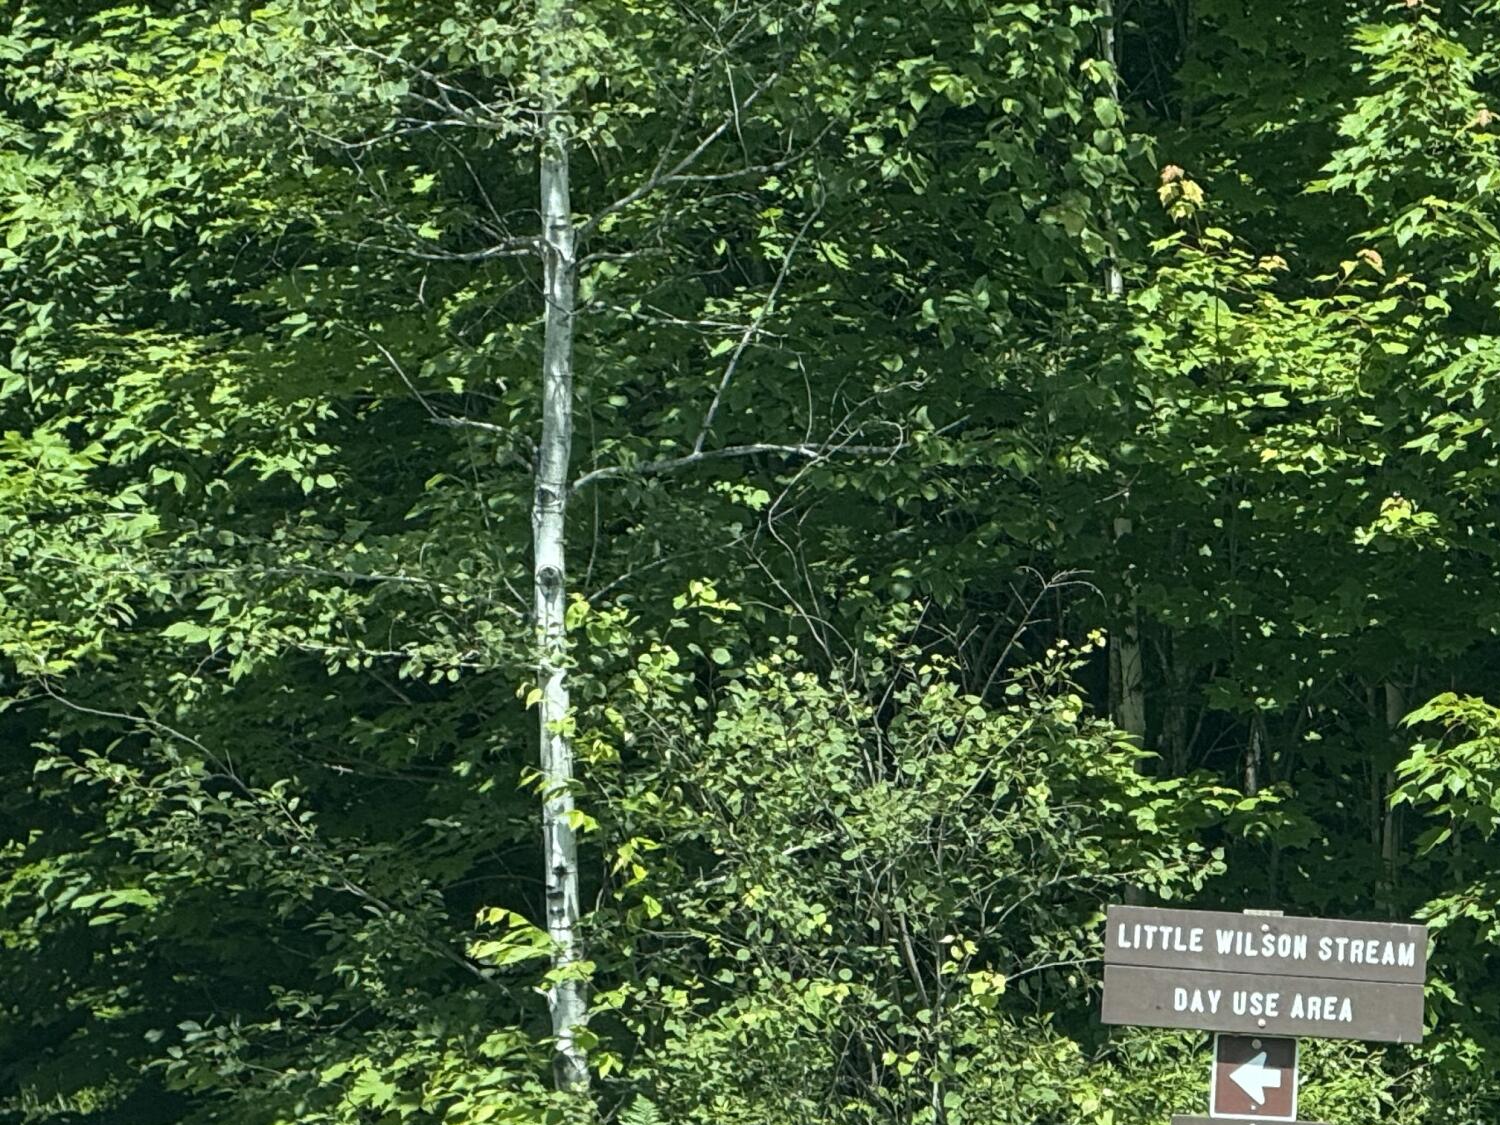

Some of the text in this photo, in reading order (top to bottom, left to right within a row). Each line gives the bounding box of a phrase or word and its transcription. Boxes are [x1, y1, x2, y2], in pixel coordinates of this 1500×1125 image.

[1118, 923, 1416, 968] LITTLE WILSON STREAM
[1174, 988, 1353, 1022] DAY USE AREA
